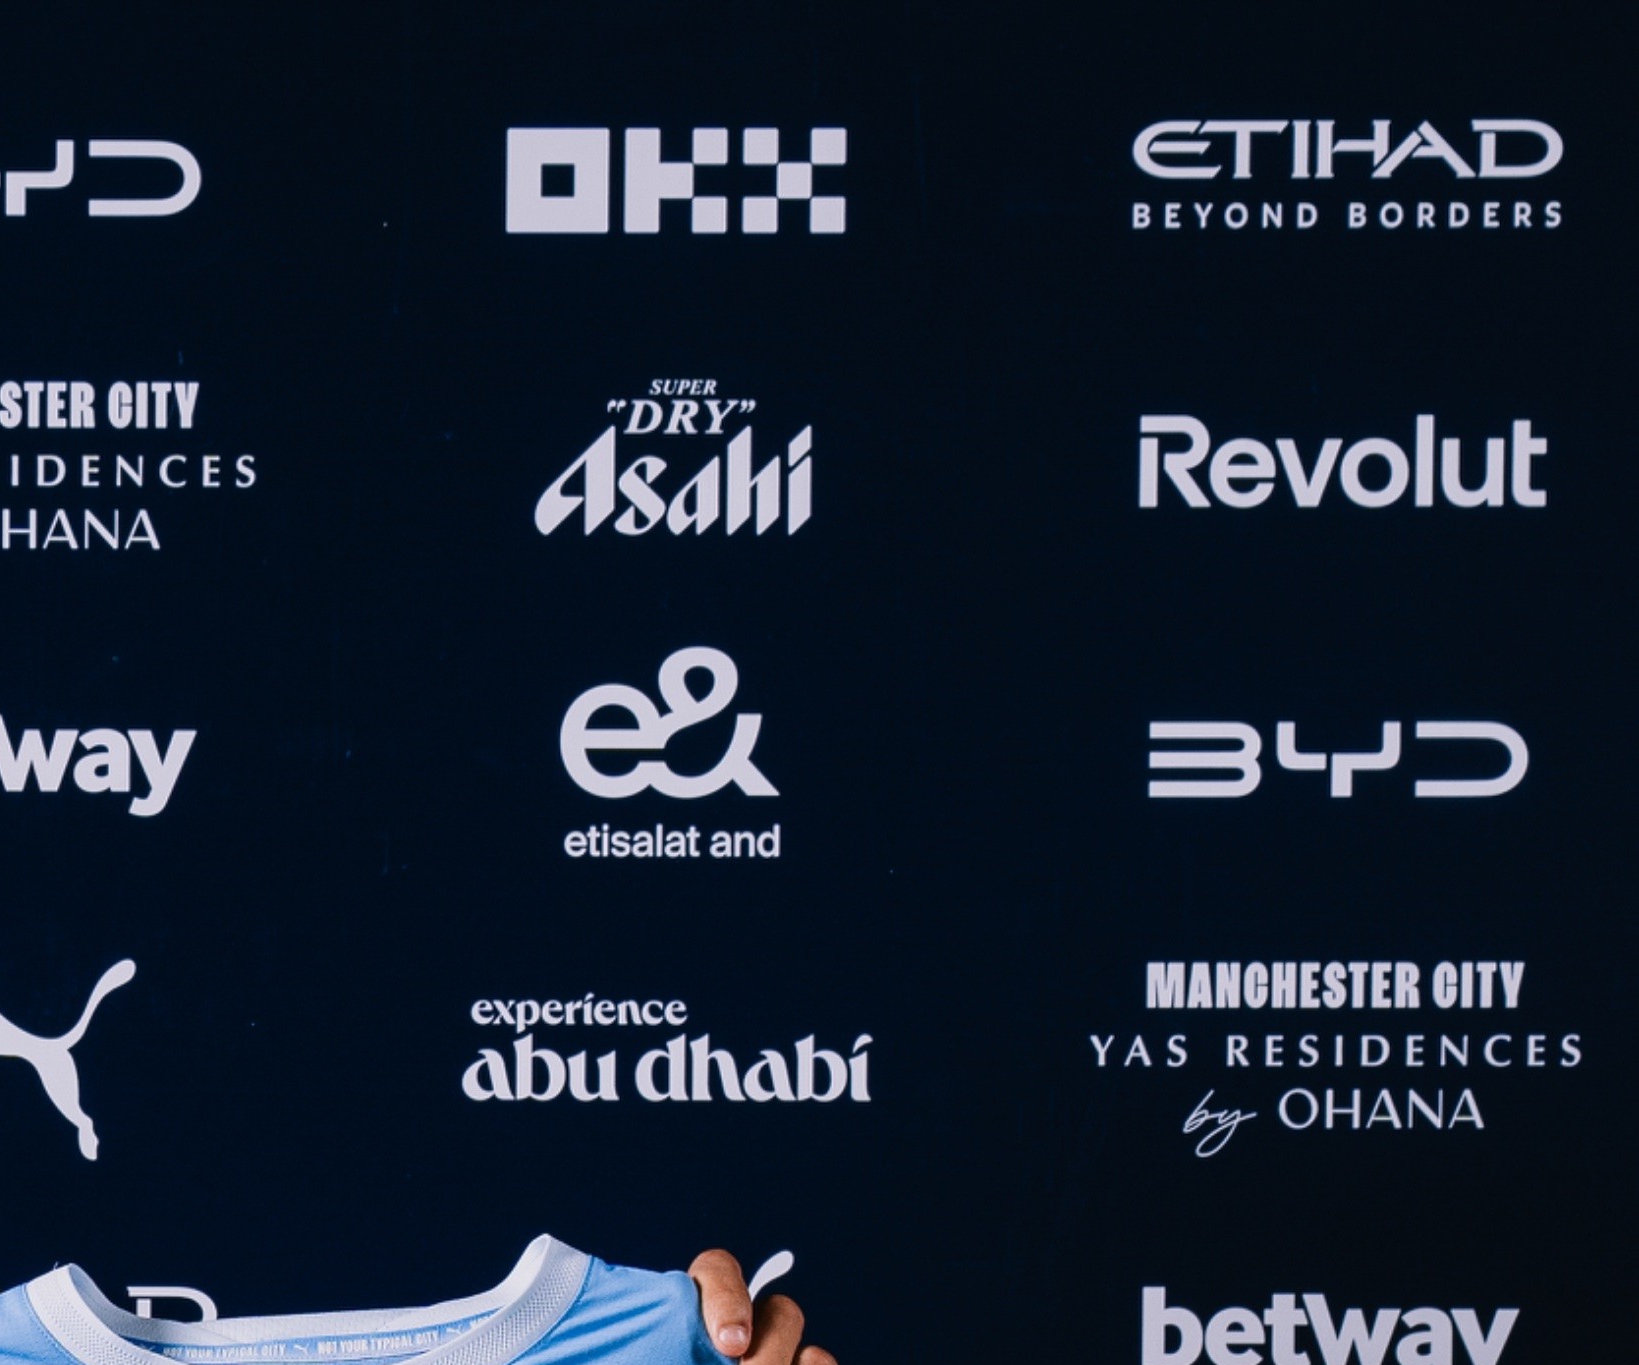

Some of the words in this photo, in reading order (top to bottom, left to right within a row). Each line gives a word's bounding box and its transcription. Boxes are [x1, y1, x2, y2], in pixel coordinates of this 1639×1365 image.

[1133, 119, 1563, 179] ETIHAD
[505, 128, 847, 234] OKX
[1133, 202, 1318, 229] BEYOND
[1349, 201, 1561, 228] BORDERS
[108, 381, 199, 429] CITY
[649, 379, 717, 395] SUPER
[534, 425, 812, 536] Asahi
[1139, 414, 1547, 508] Revolut
[1148, 721, 1529, 798] BYD
[564, 823, 700, 858] etisalat
[709, 824, 780, 858] and
[1146, 961, 1420, 1009] MANCHESTER
[1433, 961, 1525, 1009] CITY
[462, 1033, 619, 1102] abu
[1090, 1035, 1187, 1067] YAS
[1227, 1034, 1581, 1067] RESIDENCES
[1183, 1090, 1257, 1157] by
[1279, 1088, 1484, 1129] OHANA
[318, 1342, 338, 1354] NOT
[339, 1340, 368, 1353] YOUR
